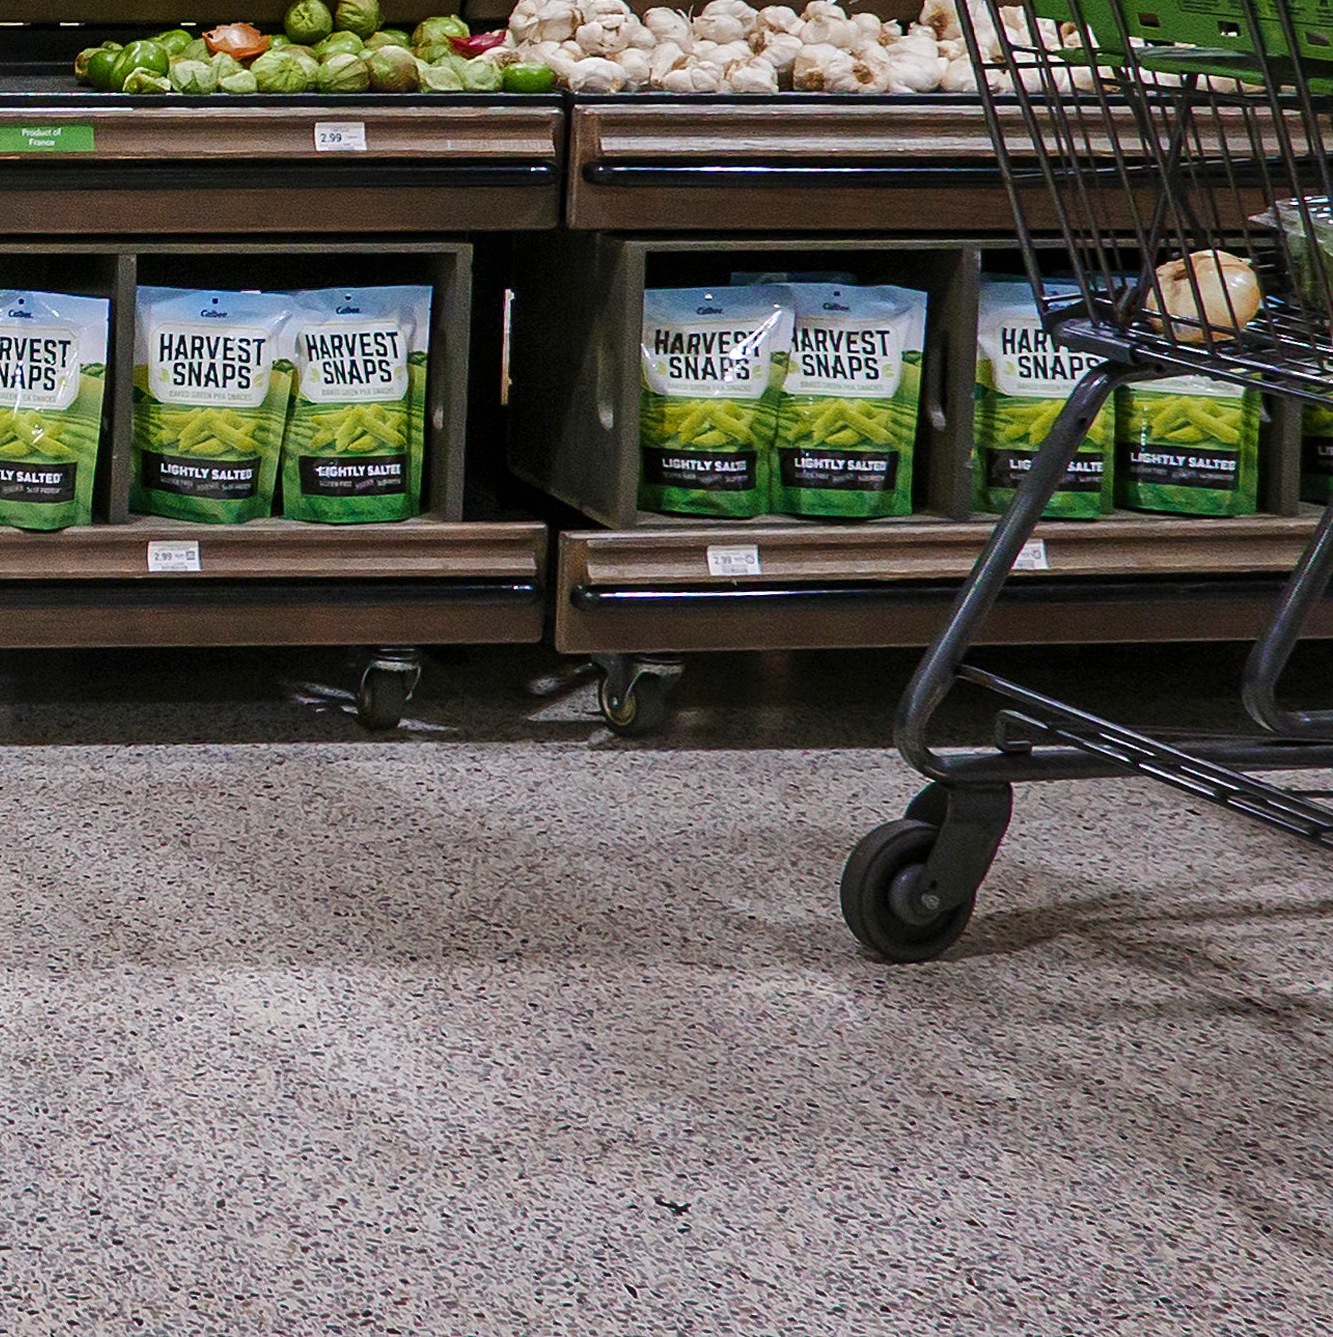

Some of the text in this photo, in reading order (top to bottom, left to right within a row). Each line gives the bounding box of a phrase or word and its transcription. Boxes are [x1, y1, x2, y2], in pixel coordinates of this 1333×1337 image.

[21, 128, 61, 137] Product of
[29, 138, 55, 147] France
[8, 309, 32, 318] Calbee
[201, 309, 227, 318] Calbee
[336, 306, 360, 314] Calbee
[159, 333, 266, 365] HARVEST
[305, 331, 398, 362] HARVEST
[654, 329, 761, 357] HARVEST
[323, 359, 391, 385] SNAPS
[669, 356, 750, 381] SNAPS
[803, 355, 879, 379] SNAPS
[173, 362, 251, 389] SNAPS
[662, 458, 711, 472] LIGHTLY
[794, 458, 845, 472] LIGHTLY
[1131, 452, 1236, 471] LIGHTLY SALTED
[16, 471, 61, 484] SALTED
[160, 463, 252, 480] LIGHTLY SALTED
[317, 464, 360, 478] LIGHTLY
